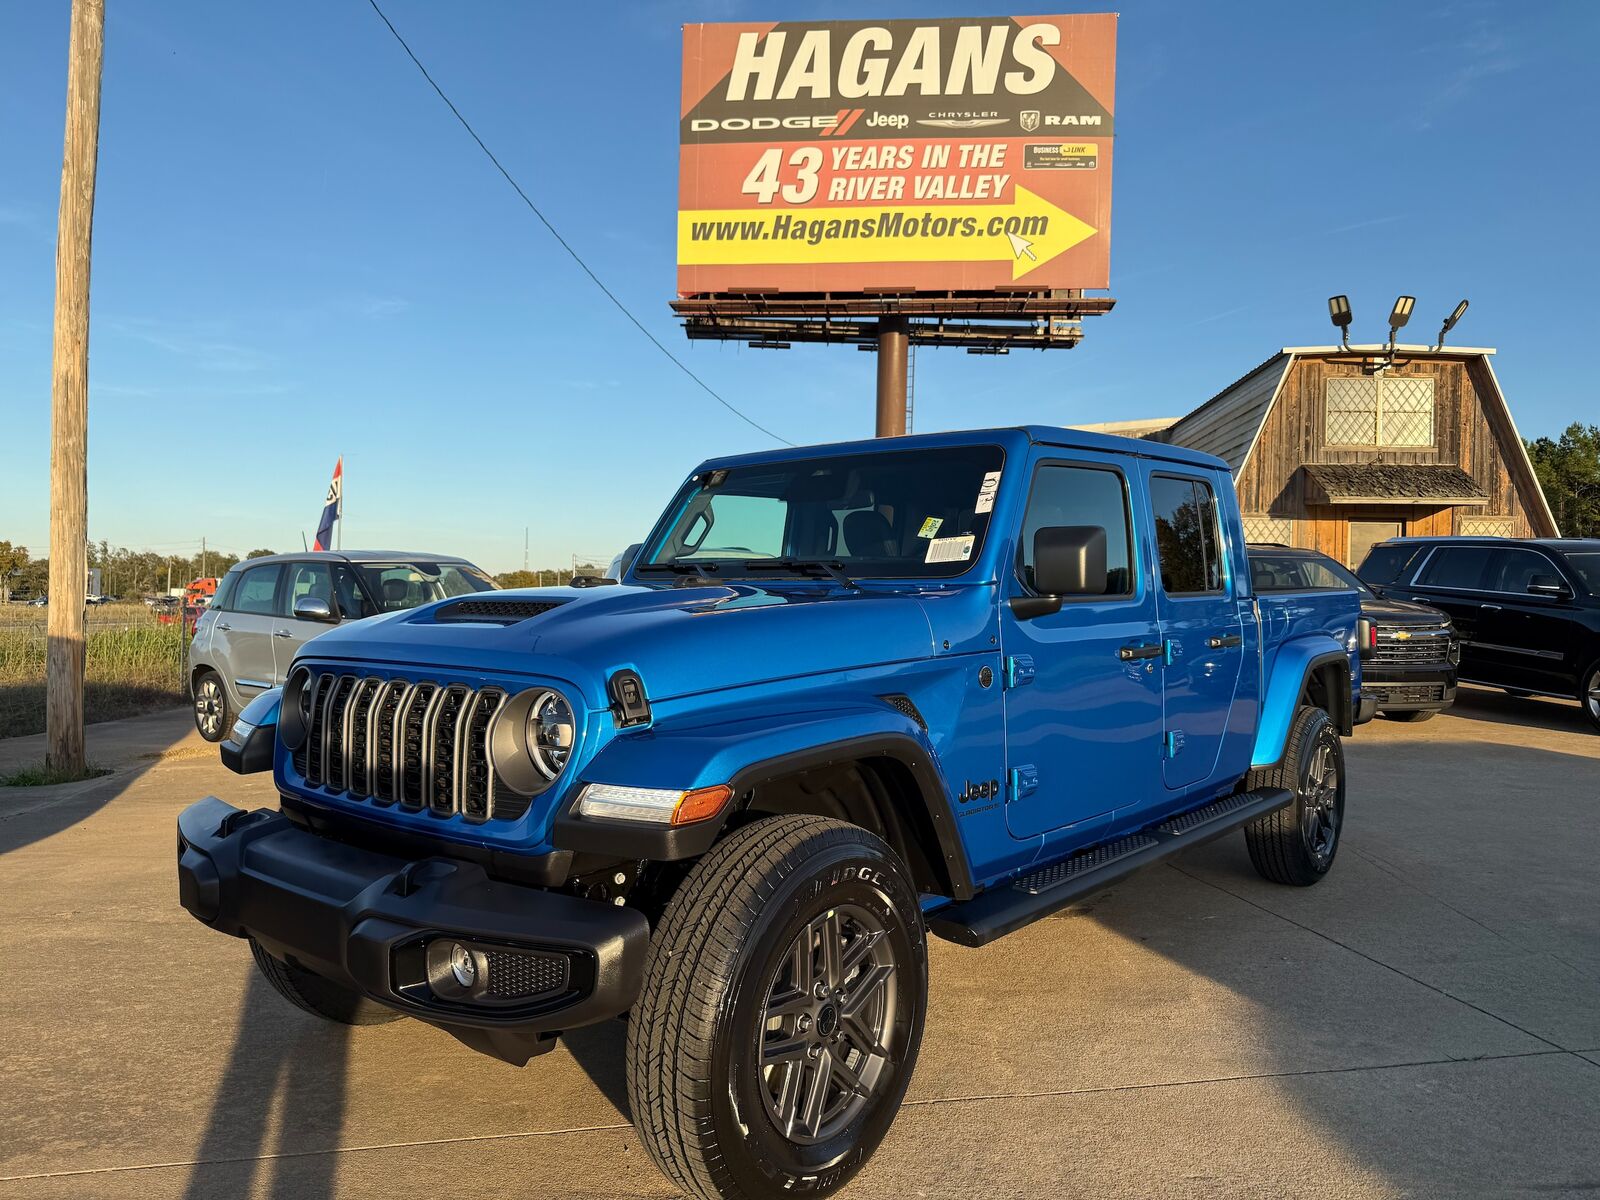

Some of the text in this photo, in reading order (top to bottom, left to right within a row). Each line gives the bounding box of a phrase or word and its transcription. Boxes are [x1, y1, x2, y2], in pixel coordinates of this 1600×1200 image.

[725, 23, 1061, 101] HAGANS
[691, 115, 839, 132] DODGE
[866, 111, 909, 129] Jeep
[1044, 115, 1102, 126] RAM
[831, 143, 1008, 171] YEARS IN THE
[741, 147, 824, 204] 43
[828, 174, 1011, 201] RIVER VALLEY
[691, 212, 1049, 246] www.HagansMotors.com
[958, 779, 999, 803] Jeep
